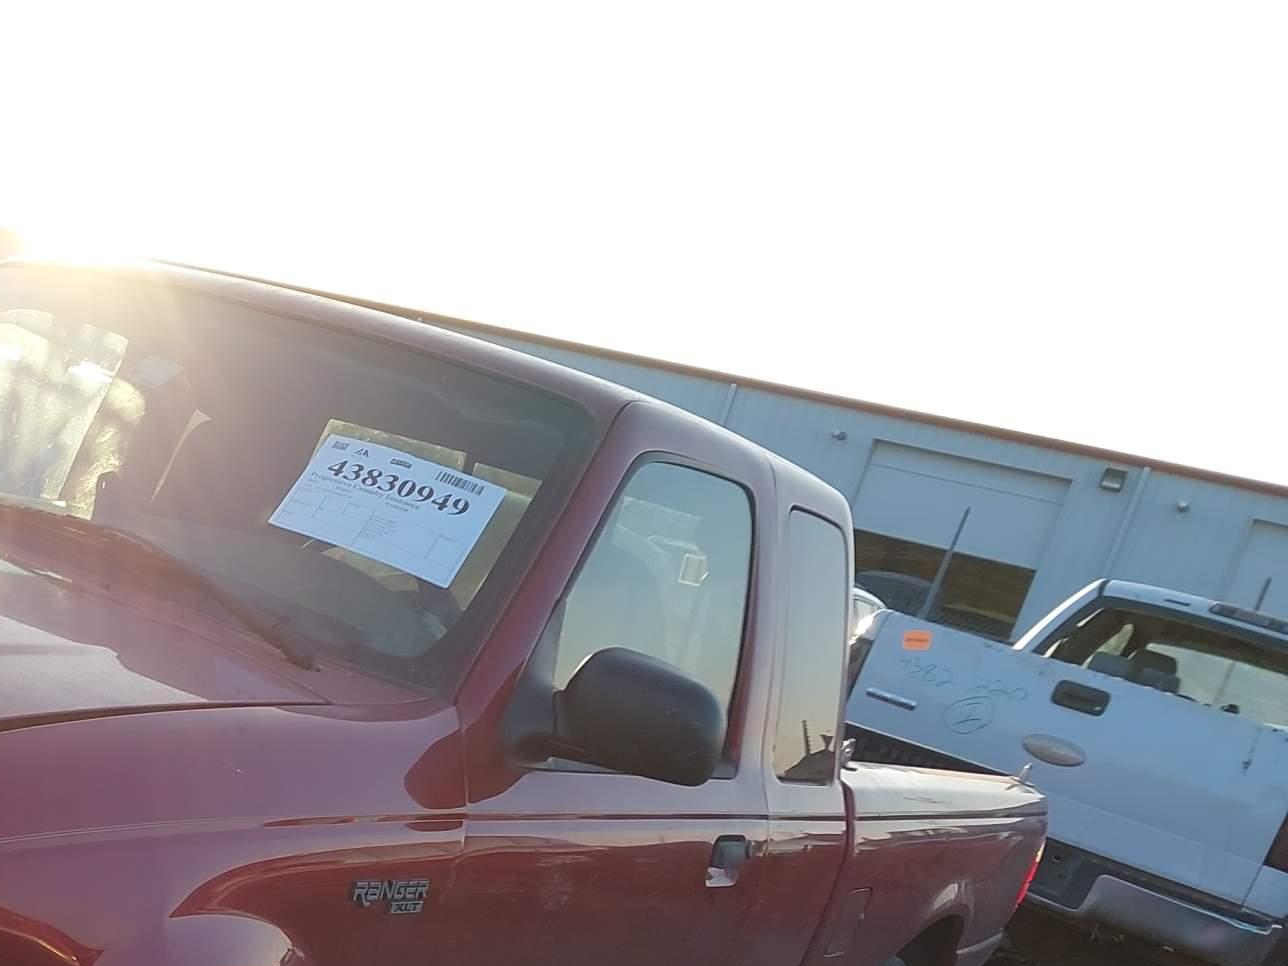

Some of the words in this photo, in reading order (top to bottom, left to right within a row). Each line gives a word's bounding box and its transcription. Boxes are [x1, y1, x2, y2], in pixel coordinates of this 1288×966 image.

[327, 460, 470, 515] 43830949
[353, 879, 430, 907] RANGER
[392, 902, 419, 913] XLT
